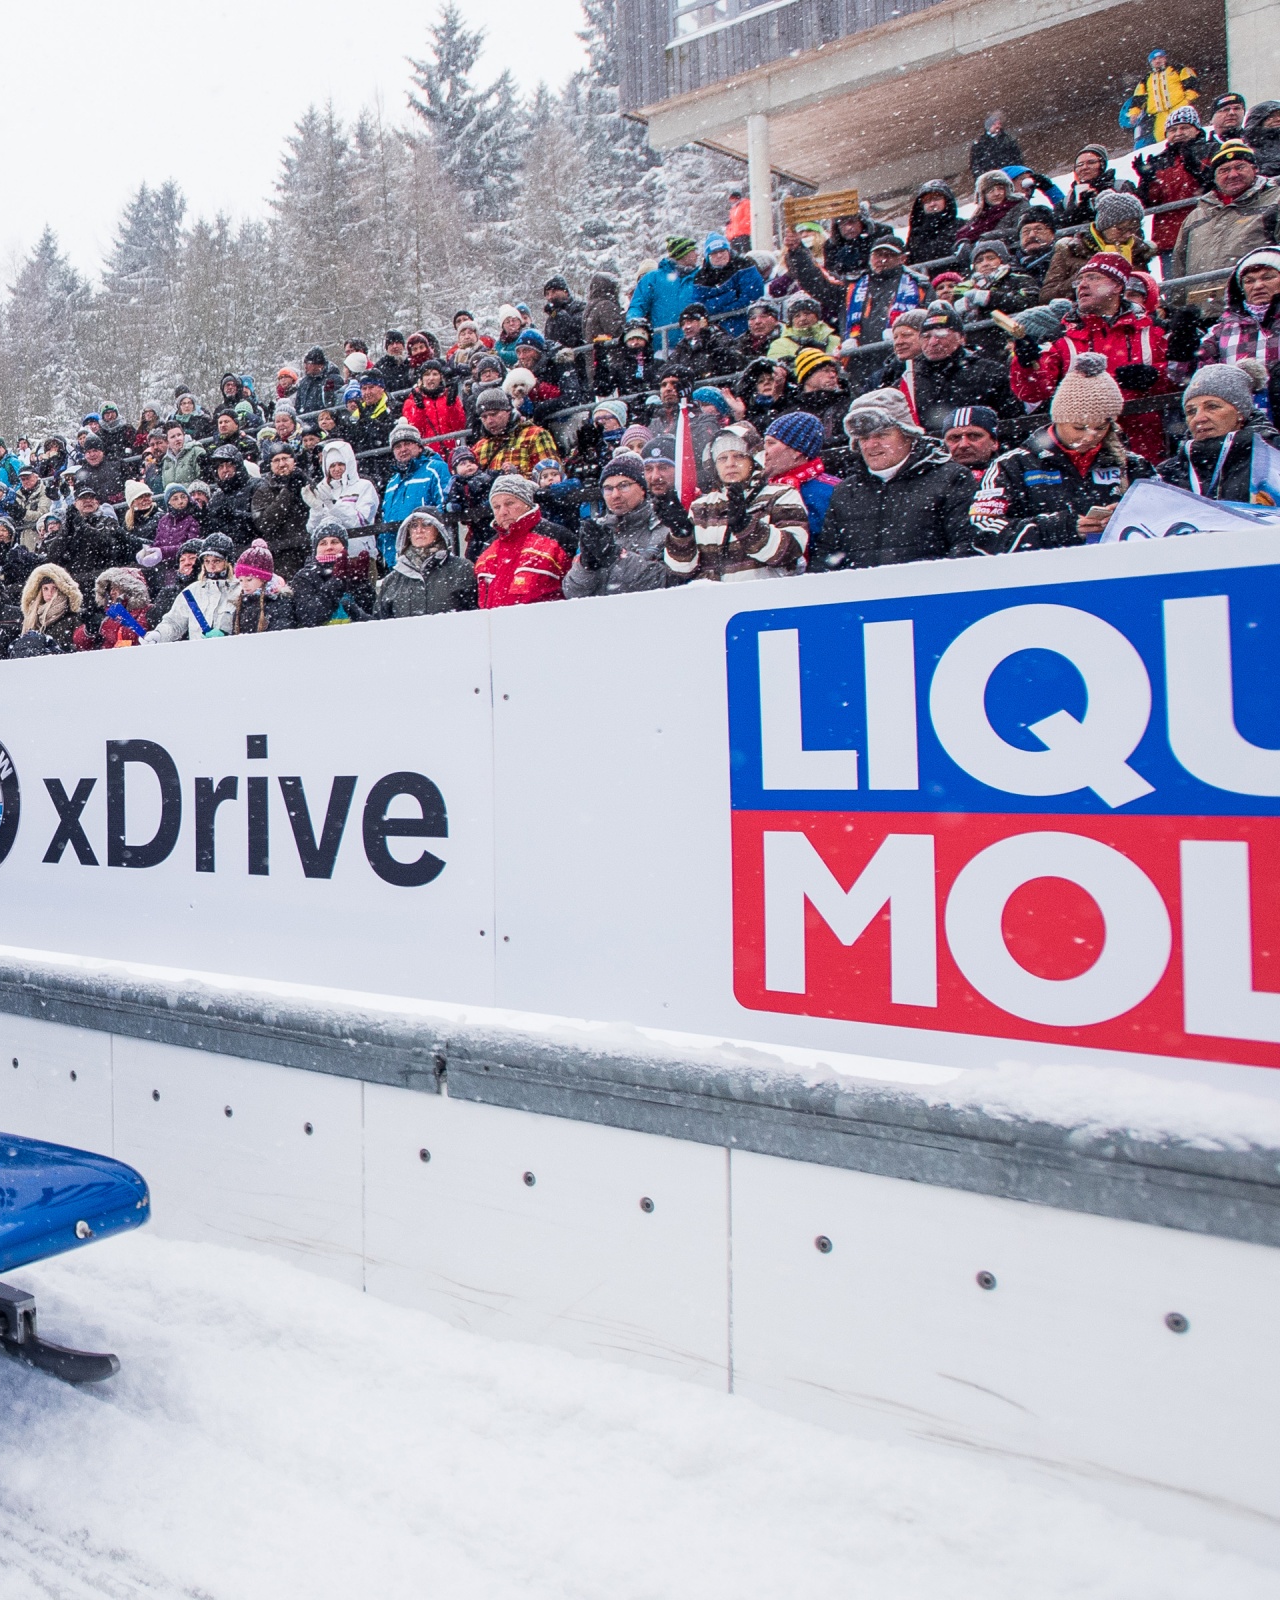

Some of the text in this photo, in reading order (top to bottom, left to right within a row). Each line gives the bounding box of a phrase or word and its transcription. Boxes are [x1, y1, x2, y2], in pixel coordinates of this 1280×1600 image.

[1098, 470, 1120, 480] VIS
[757, 594, 1280, 809] LIQU
[42, 733, 449, 888] xDrive
[763, 830, 1280, 1044] MOL
